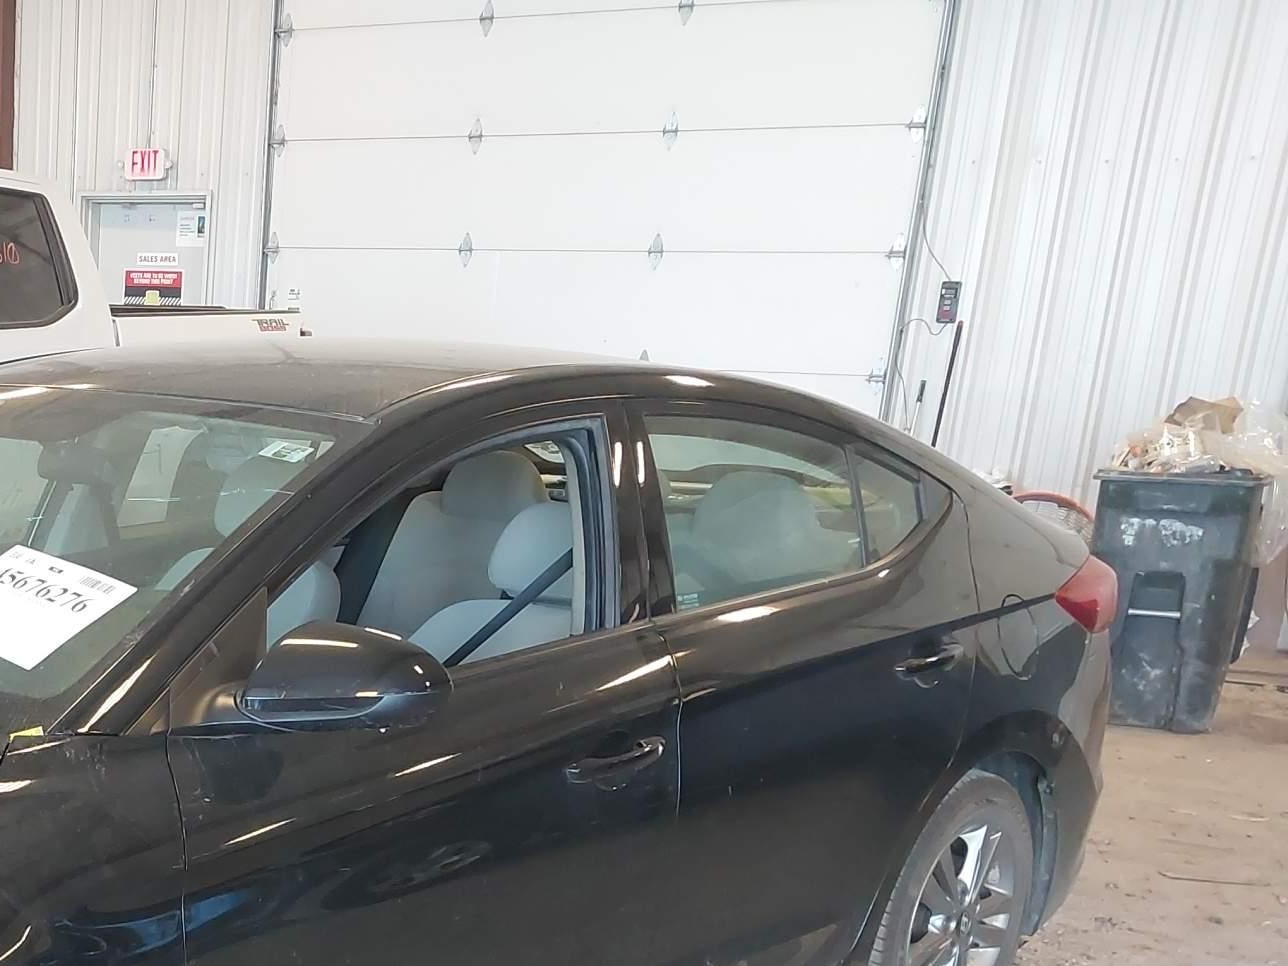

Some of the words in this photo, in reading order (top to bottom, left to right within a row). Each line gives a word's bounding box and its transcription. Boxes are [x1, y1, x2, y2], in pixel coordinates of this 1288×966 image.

[131, 150, 159, 176] EXIT
[138, 255, 158, 263] SALES
[159, 255, 177, 263] AREA
